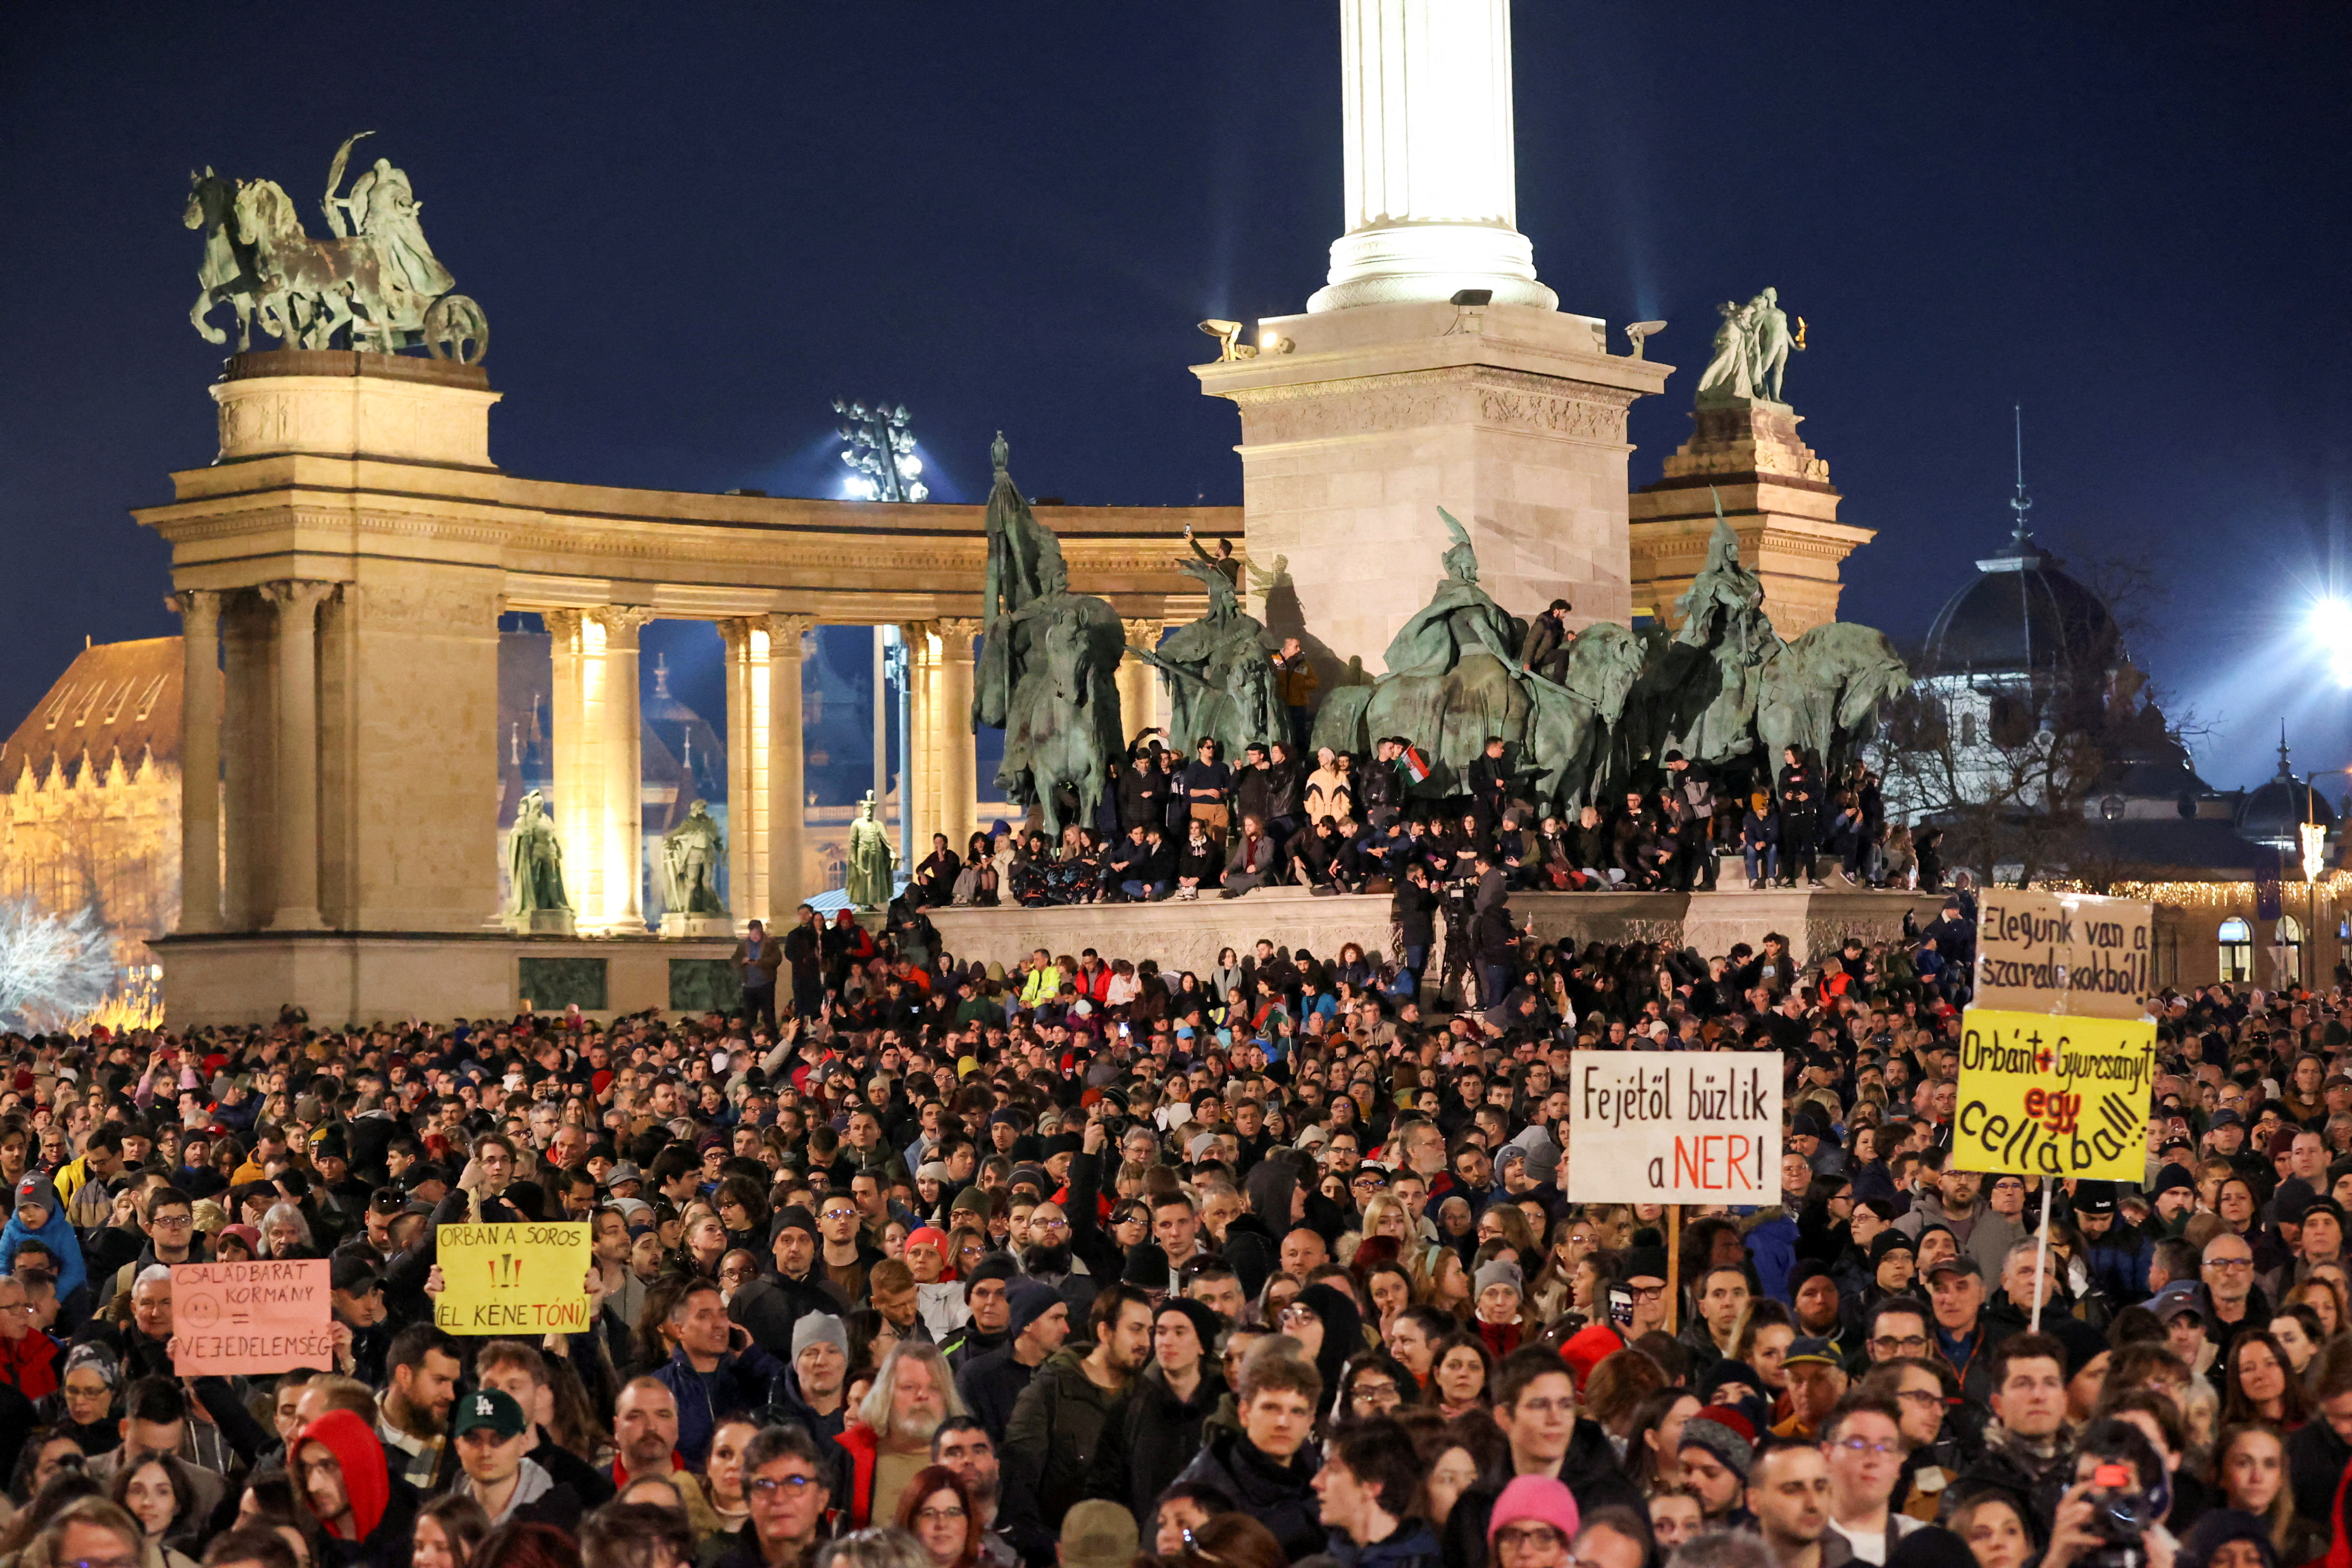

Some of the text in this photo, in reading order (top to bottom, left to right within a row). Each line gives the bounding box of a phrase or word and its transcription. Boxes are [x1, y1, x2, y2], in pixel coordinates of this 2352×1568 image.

[1984, 906, 2147, 950] Elegünk van a
[1585, 1066, 1768, 1128] Fejétől bűzlik
[2025, 1088, 2082, 1133] egy
[1959, 1093, 2147, 1174] cellába!!!
[1648, 1135, 1763, 1190] a NER!
[440, 1225, 580, 1247] ORBÁN A SOROS
[177, 1262, 309, 1284] CSALÁDBARÁT
[226, 1285, 313, 1304] KORMÁNY
[437, 1303, 464, 1327] (EL
[475, 1395, 493, 1416] LA
